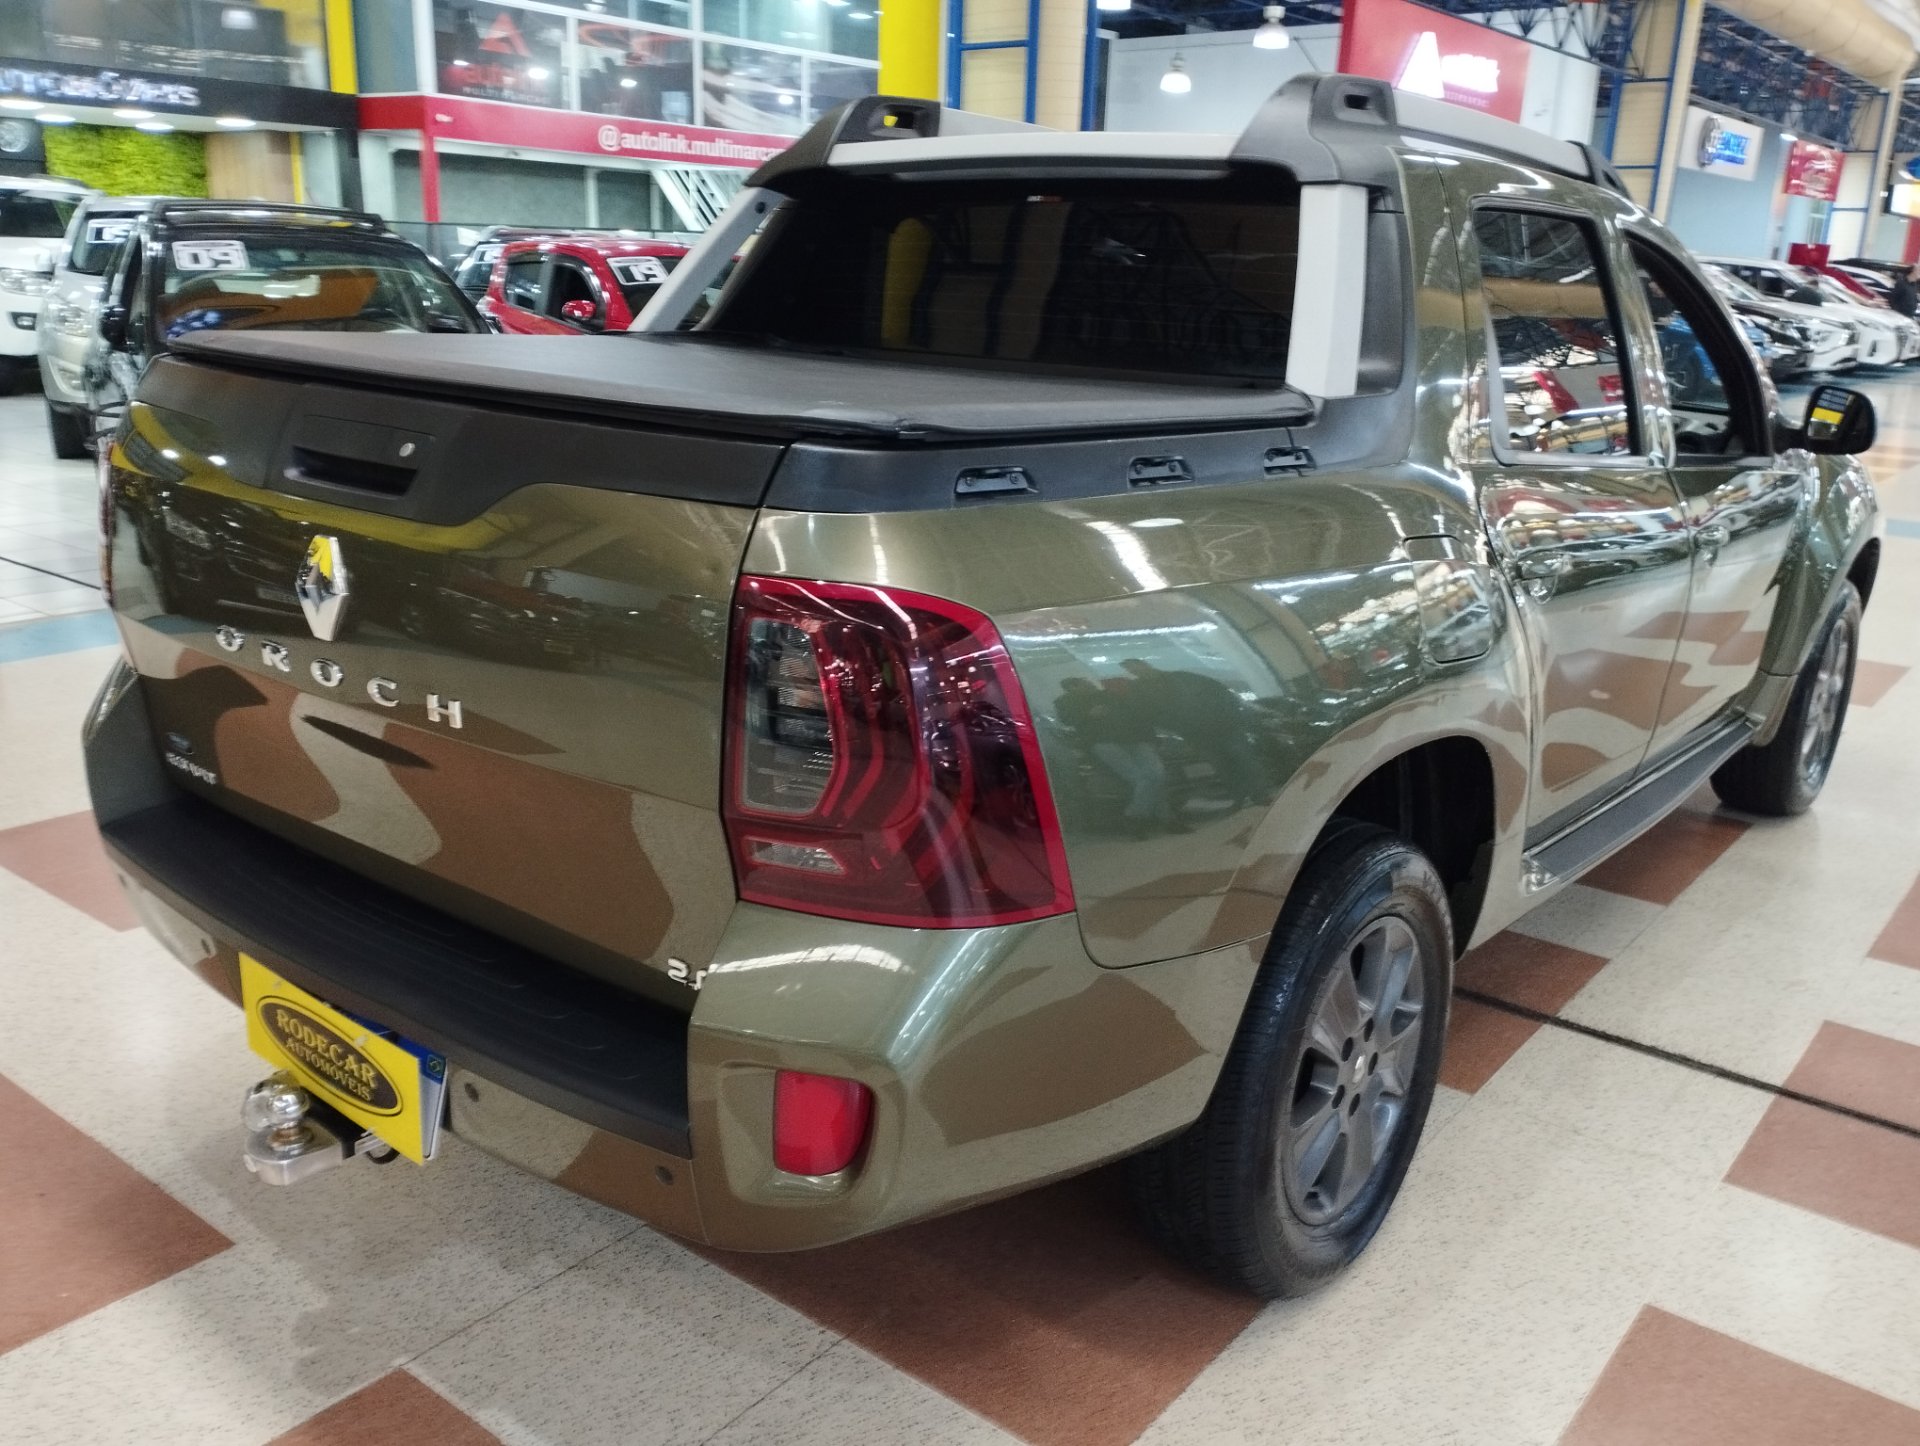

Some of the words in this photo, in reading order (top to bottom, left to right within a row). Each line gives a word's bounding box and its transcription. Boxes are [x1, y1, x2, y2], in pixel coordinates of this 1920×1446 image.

[598, 124, 786, 161] @autolink.multimarca
[179, 249, 239, 270] 09
[629, 264, 667, 282] 19
[215, 624, 463, 729] OROCH
[276, 1008, 378, 1090] RODECAR
[286, 1037, 371, 1102] AUTOMOVEIS
